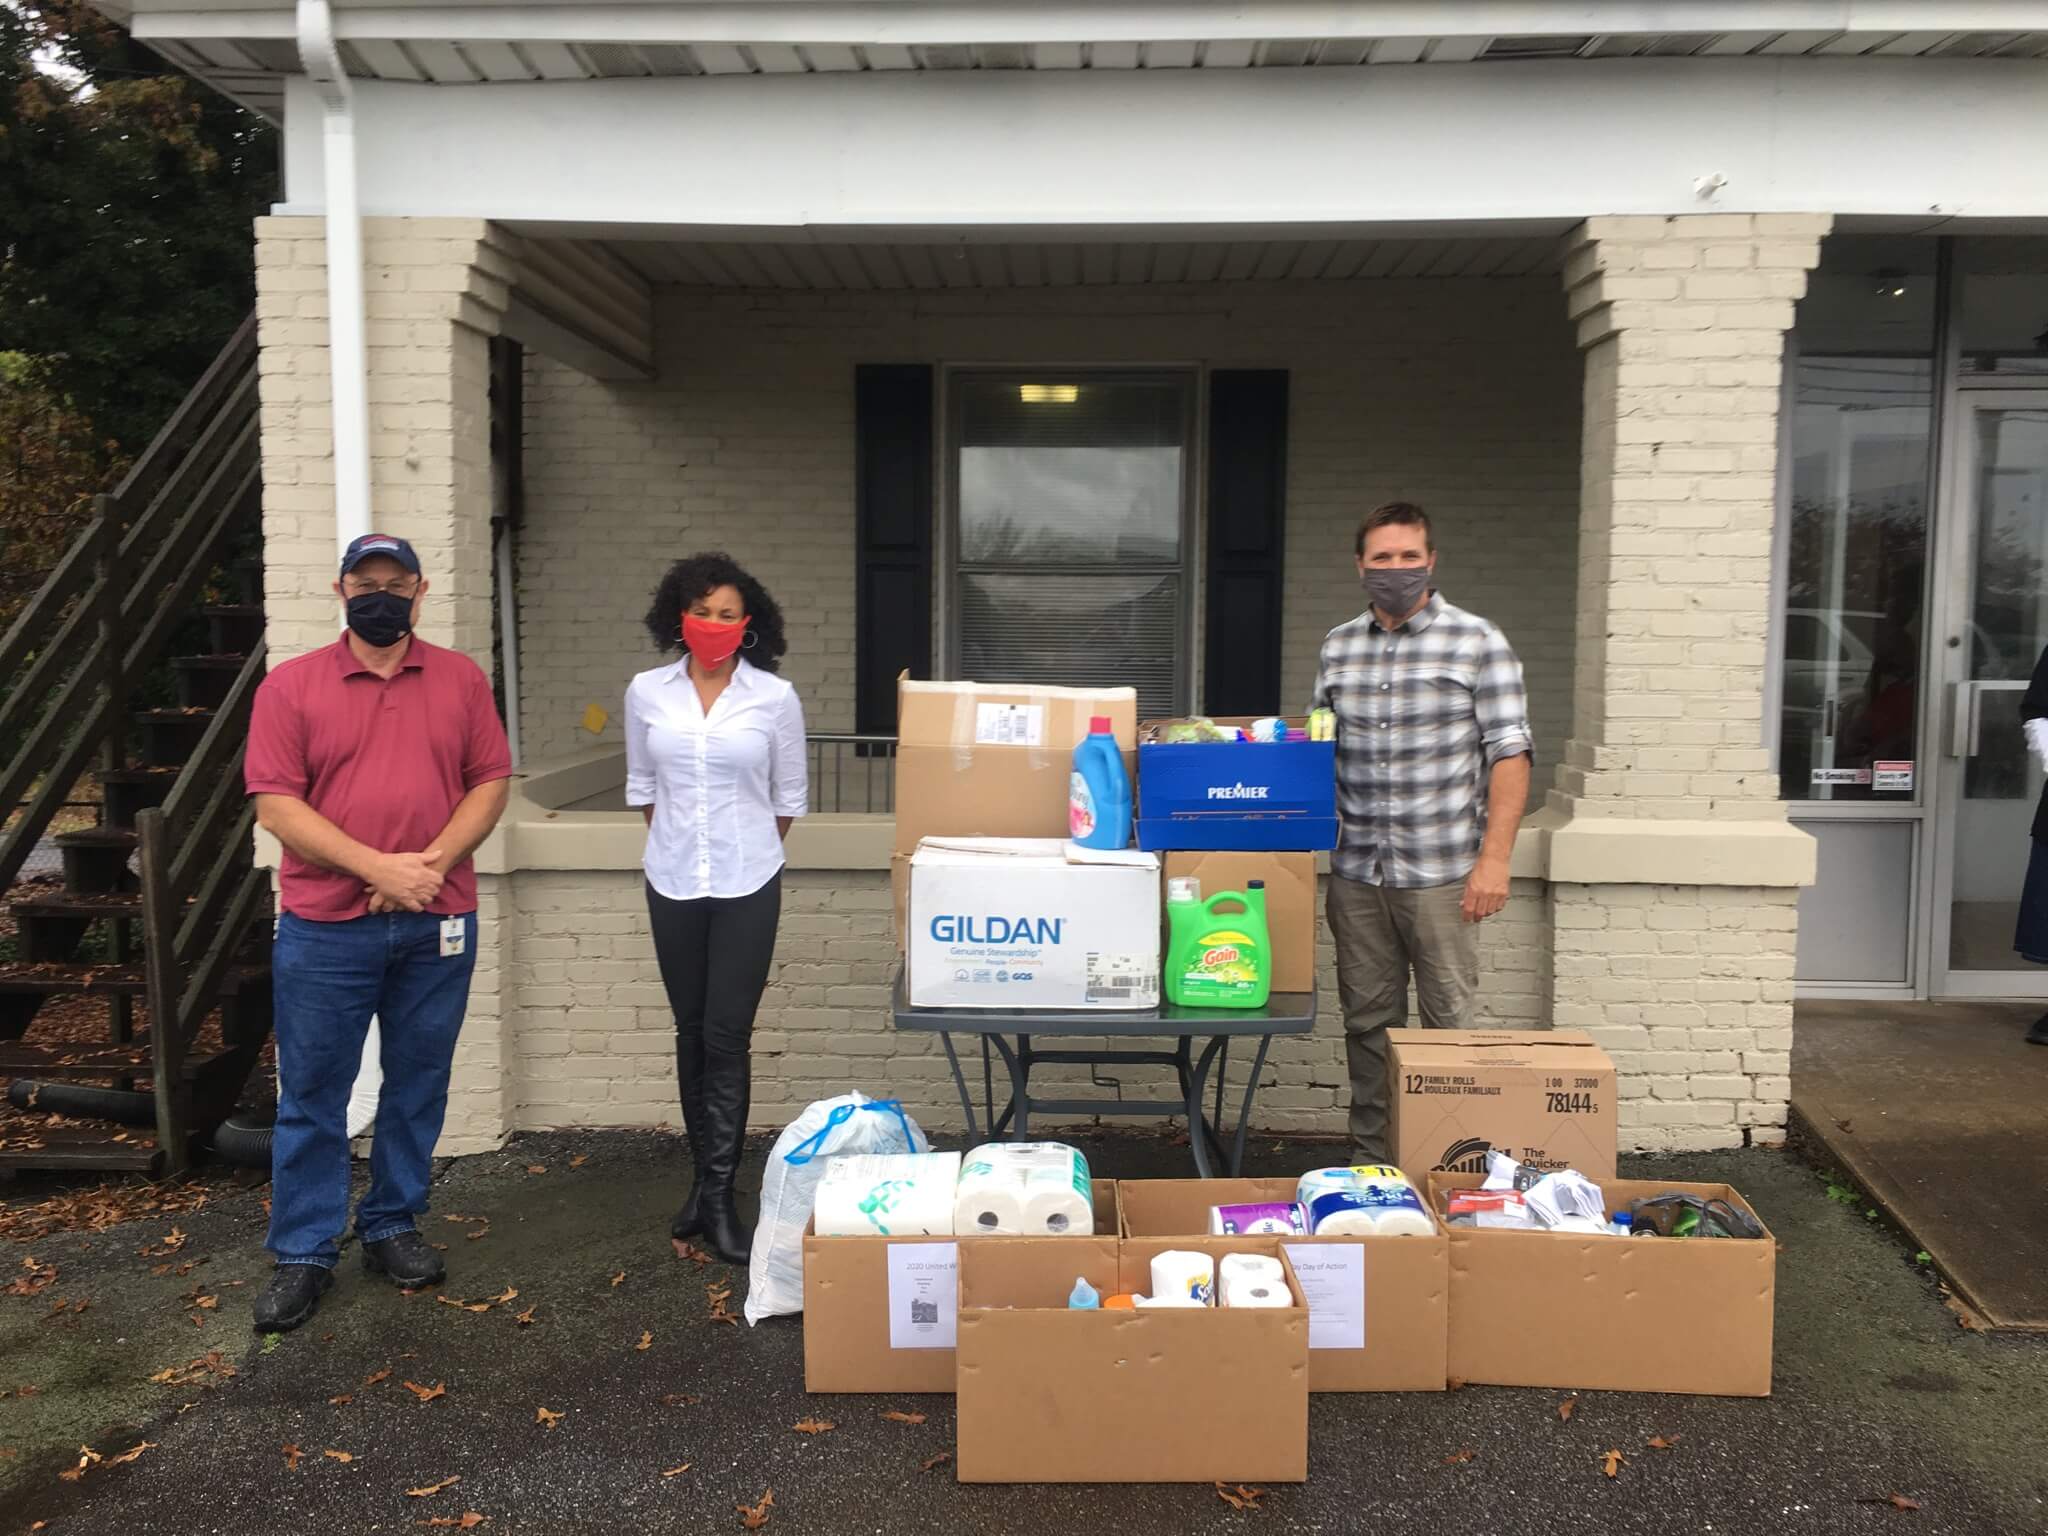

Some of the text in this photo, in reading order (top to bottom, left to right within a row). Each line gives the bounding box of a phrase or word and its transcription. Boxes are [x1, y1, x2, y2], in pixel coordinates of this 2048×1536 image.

[1825, 772, 1856, 782] Smoking
[1207, 784, 1268, 800] PREMIER
[930, 915, 1060, 944] GILDAN
[950, 946, 985, 956] Genuine
[1203, 949, 1238, 966] Gain
[1405, 1074, 1423, 1095] 12
[1424, 1076, 1475, 1085] FAMILY ROLLS
[1424, 1085, 1501, 1096] ROULEAUX FAMILIAUX
[1545, 1092, 1592, 1113] 78144
[1523, 1148, 1545, 1158] The
[1522, 1158, 1570, 1169] Quicker
[1341, 1189, 1415, 1204] Sparkle
[925, 1262, 948, 1270] United
[1302, 1263, 1316, 1271] Day
[1316, 1262, 1325, 1270] of
